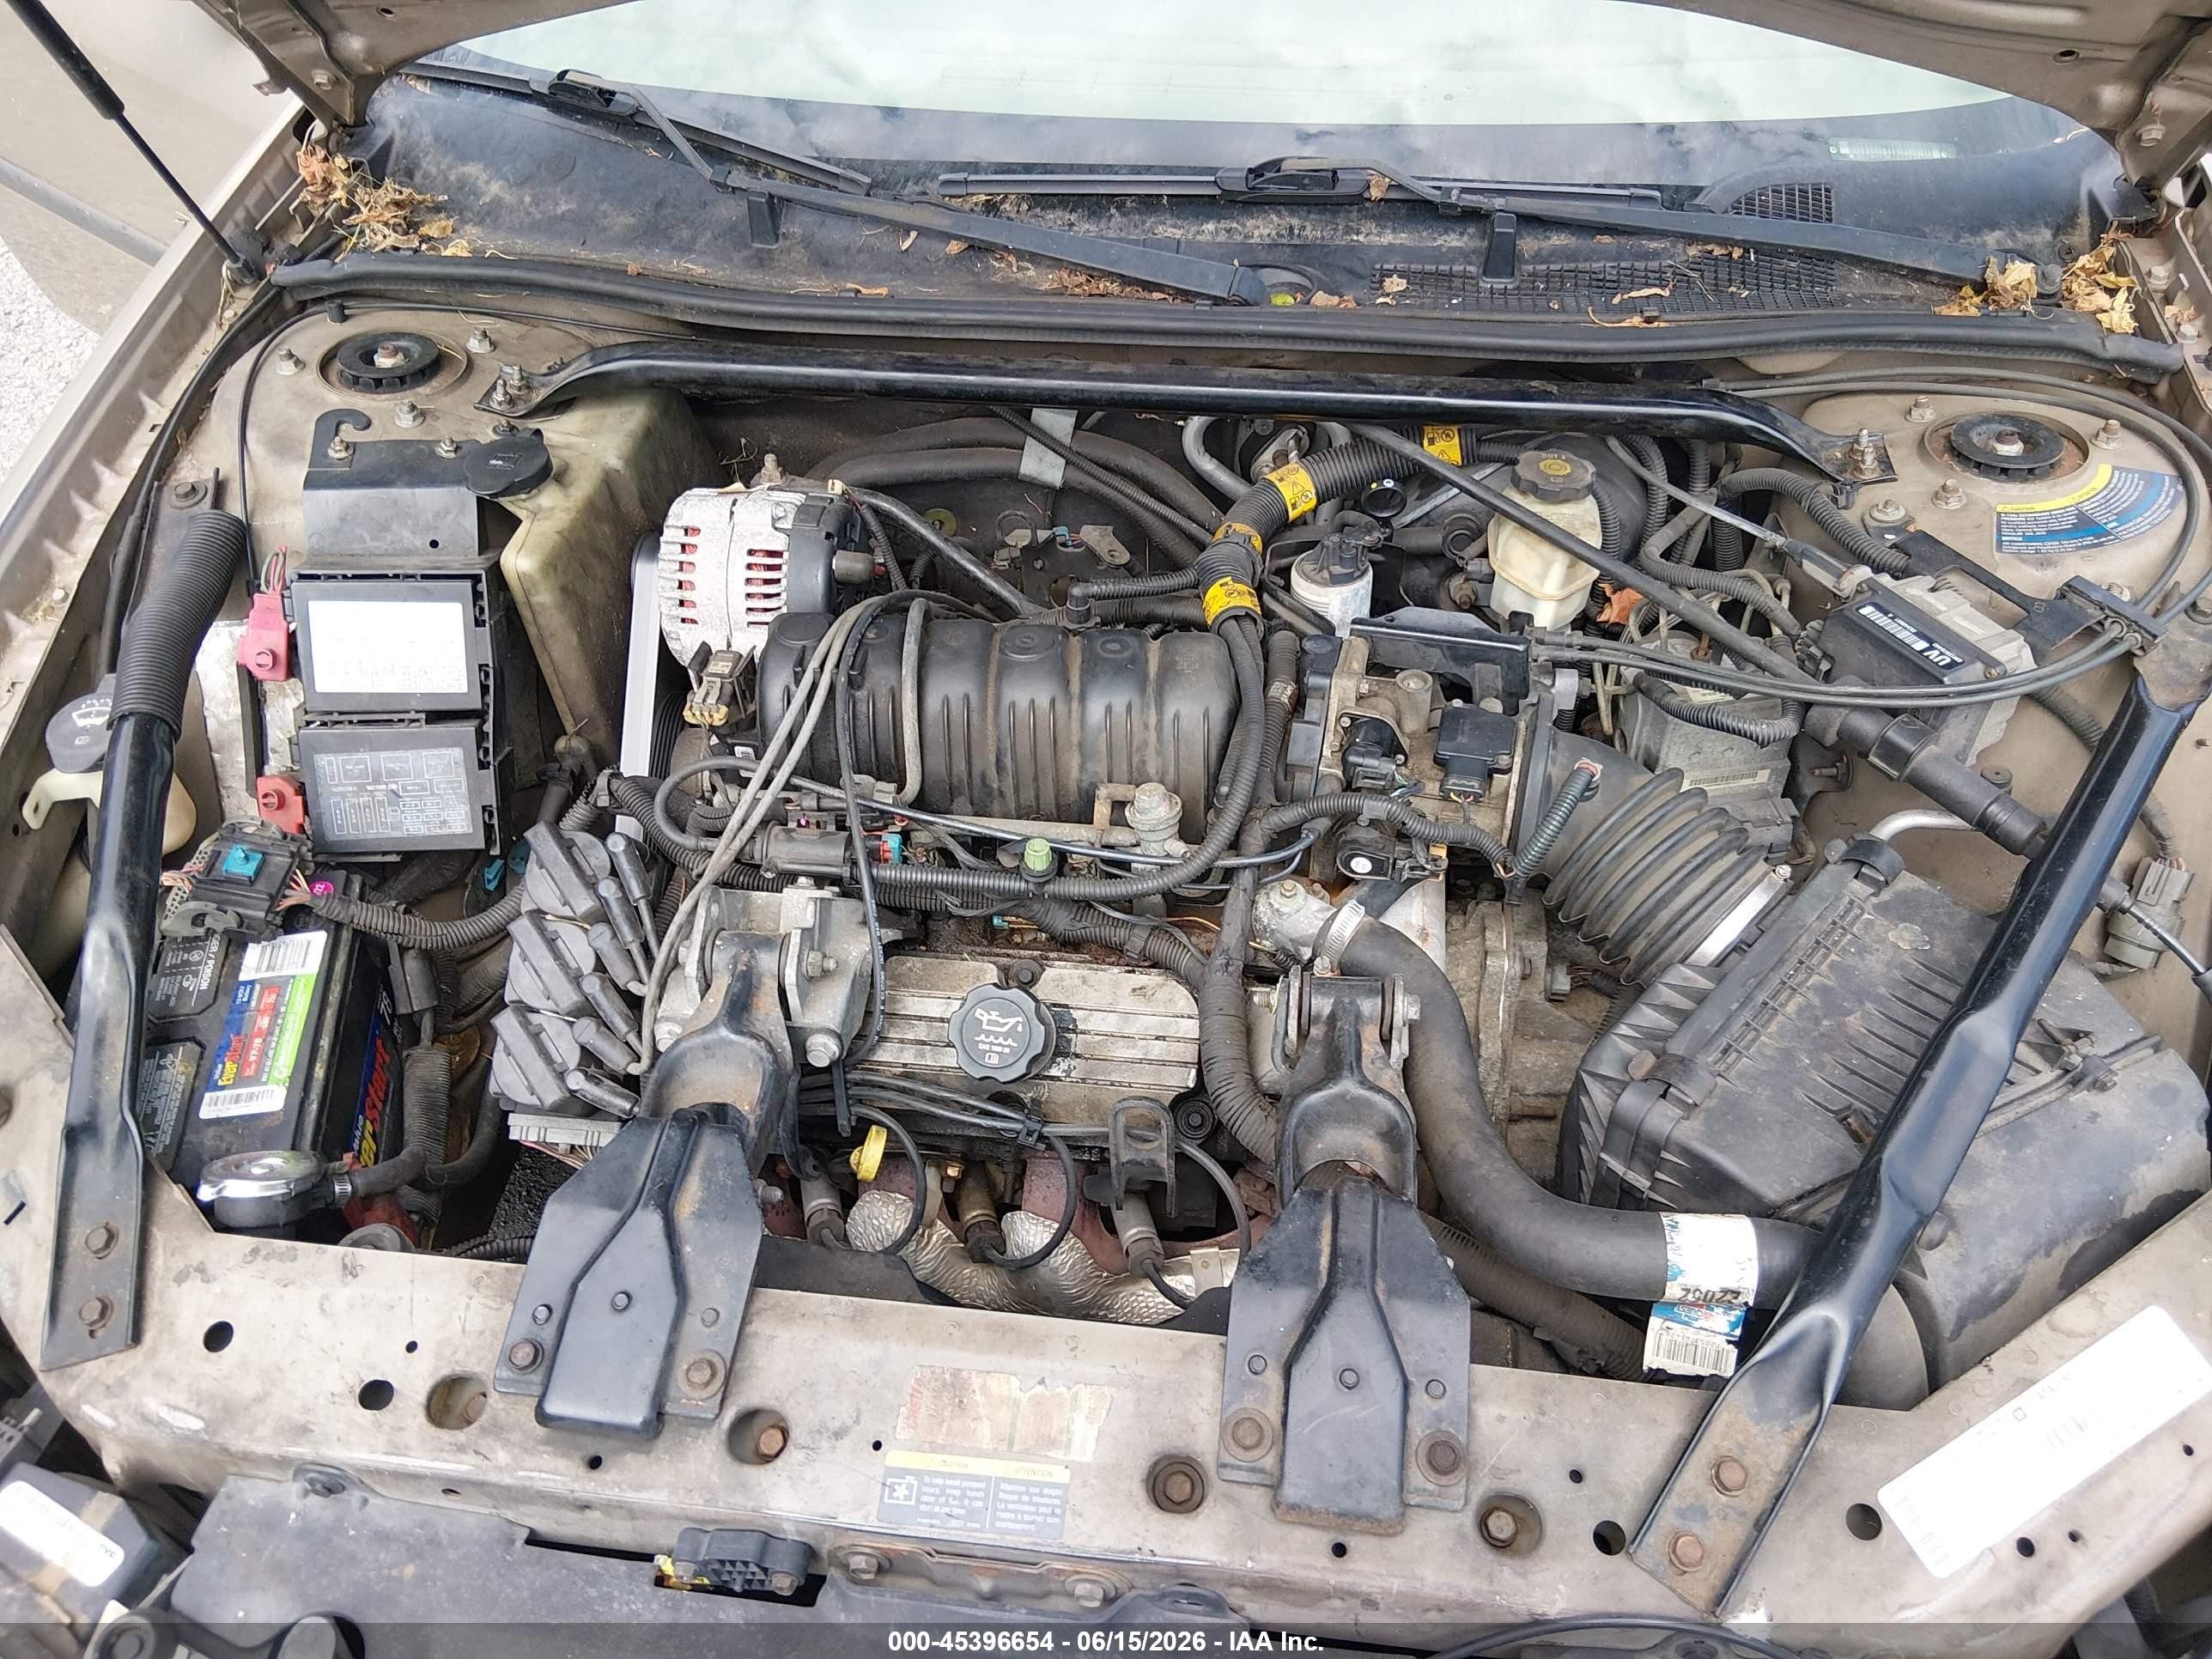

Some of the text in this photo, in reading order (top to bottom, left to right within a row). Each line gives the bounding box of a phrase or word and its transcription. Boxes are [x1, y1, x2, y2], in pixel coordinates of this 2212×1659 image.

[1923, 649, 1952, 666] UV
[198, 959, 215, 989] POISON
[218, 1034, 244, 1085] EverStart
